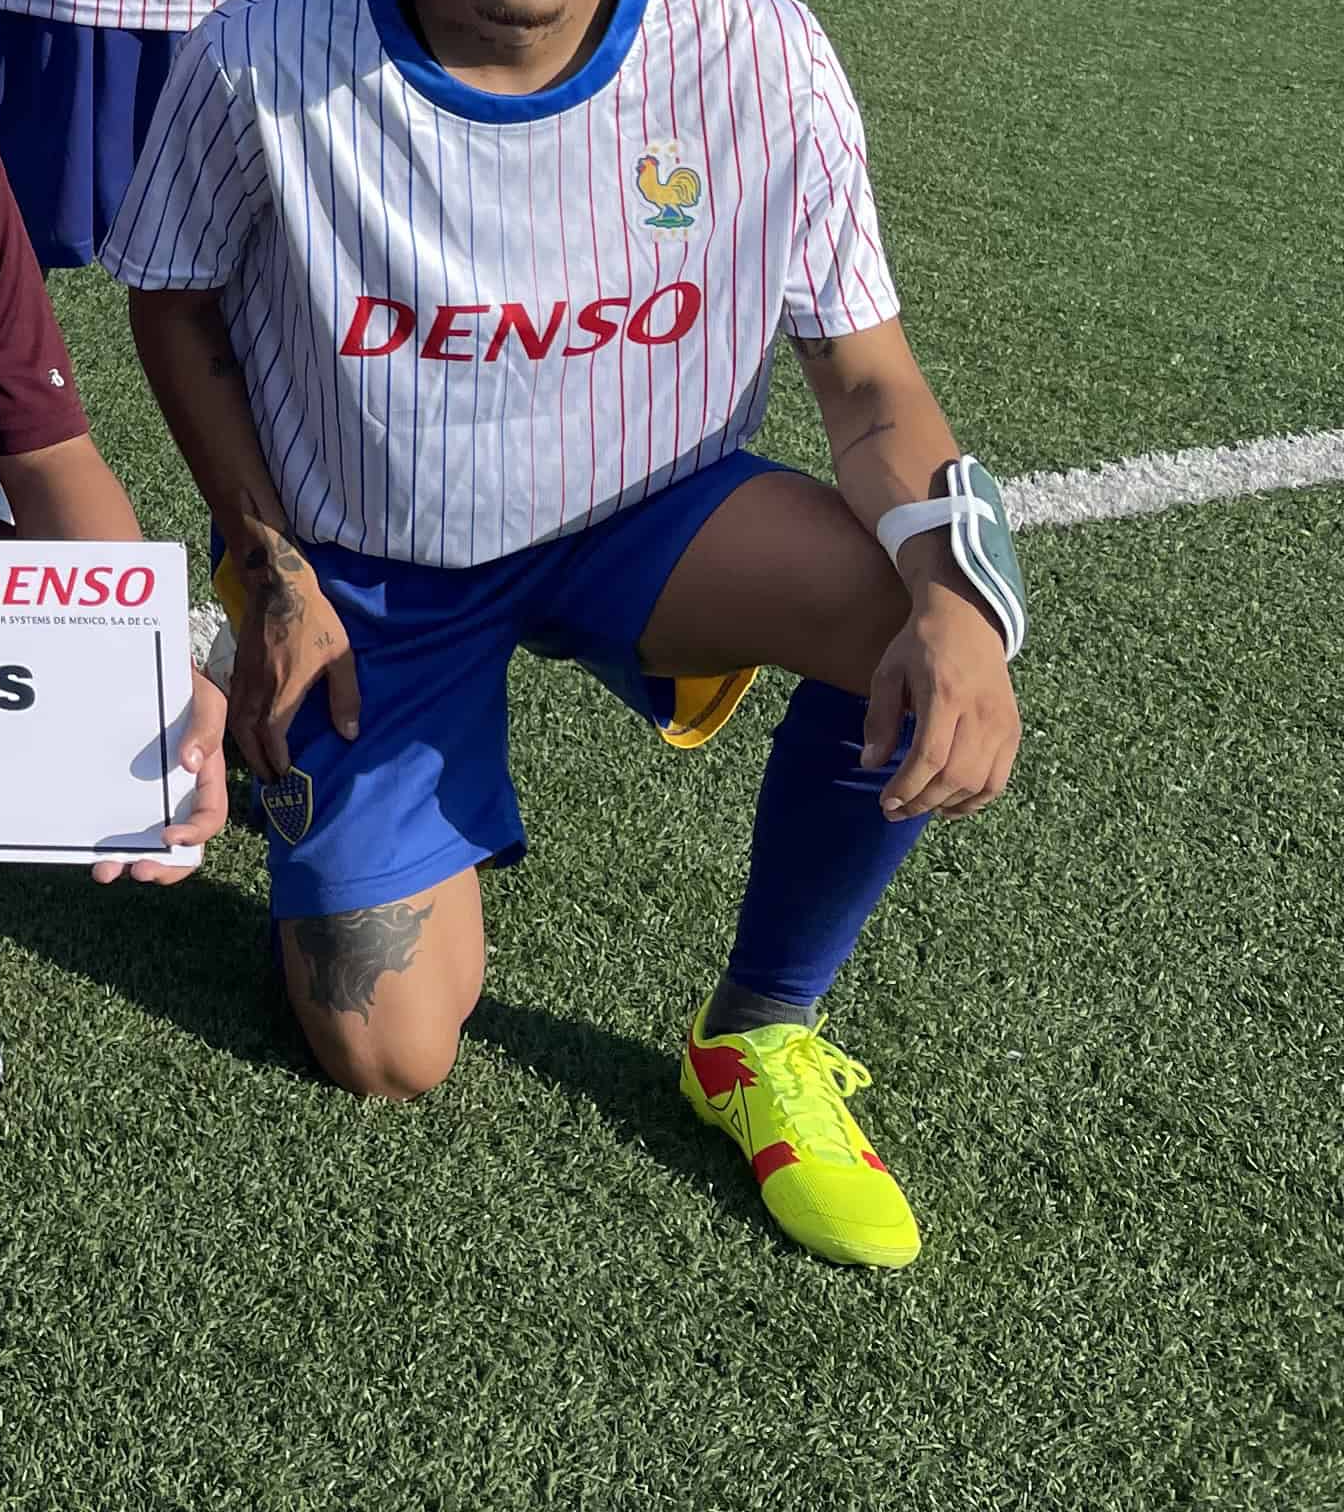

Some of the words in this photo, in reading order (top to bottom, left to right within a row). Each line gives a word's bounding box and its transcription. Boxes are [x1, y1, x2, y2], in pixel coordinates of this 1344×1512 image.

[340, 281, 702, 362] DENSO
[8, 615, 51, 625] SYSTEMS
[54, 616, 66, 625] DE
[128, 616, 141, 626] DE
